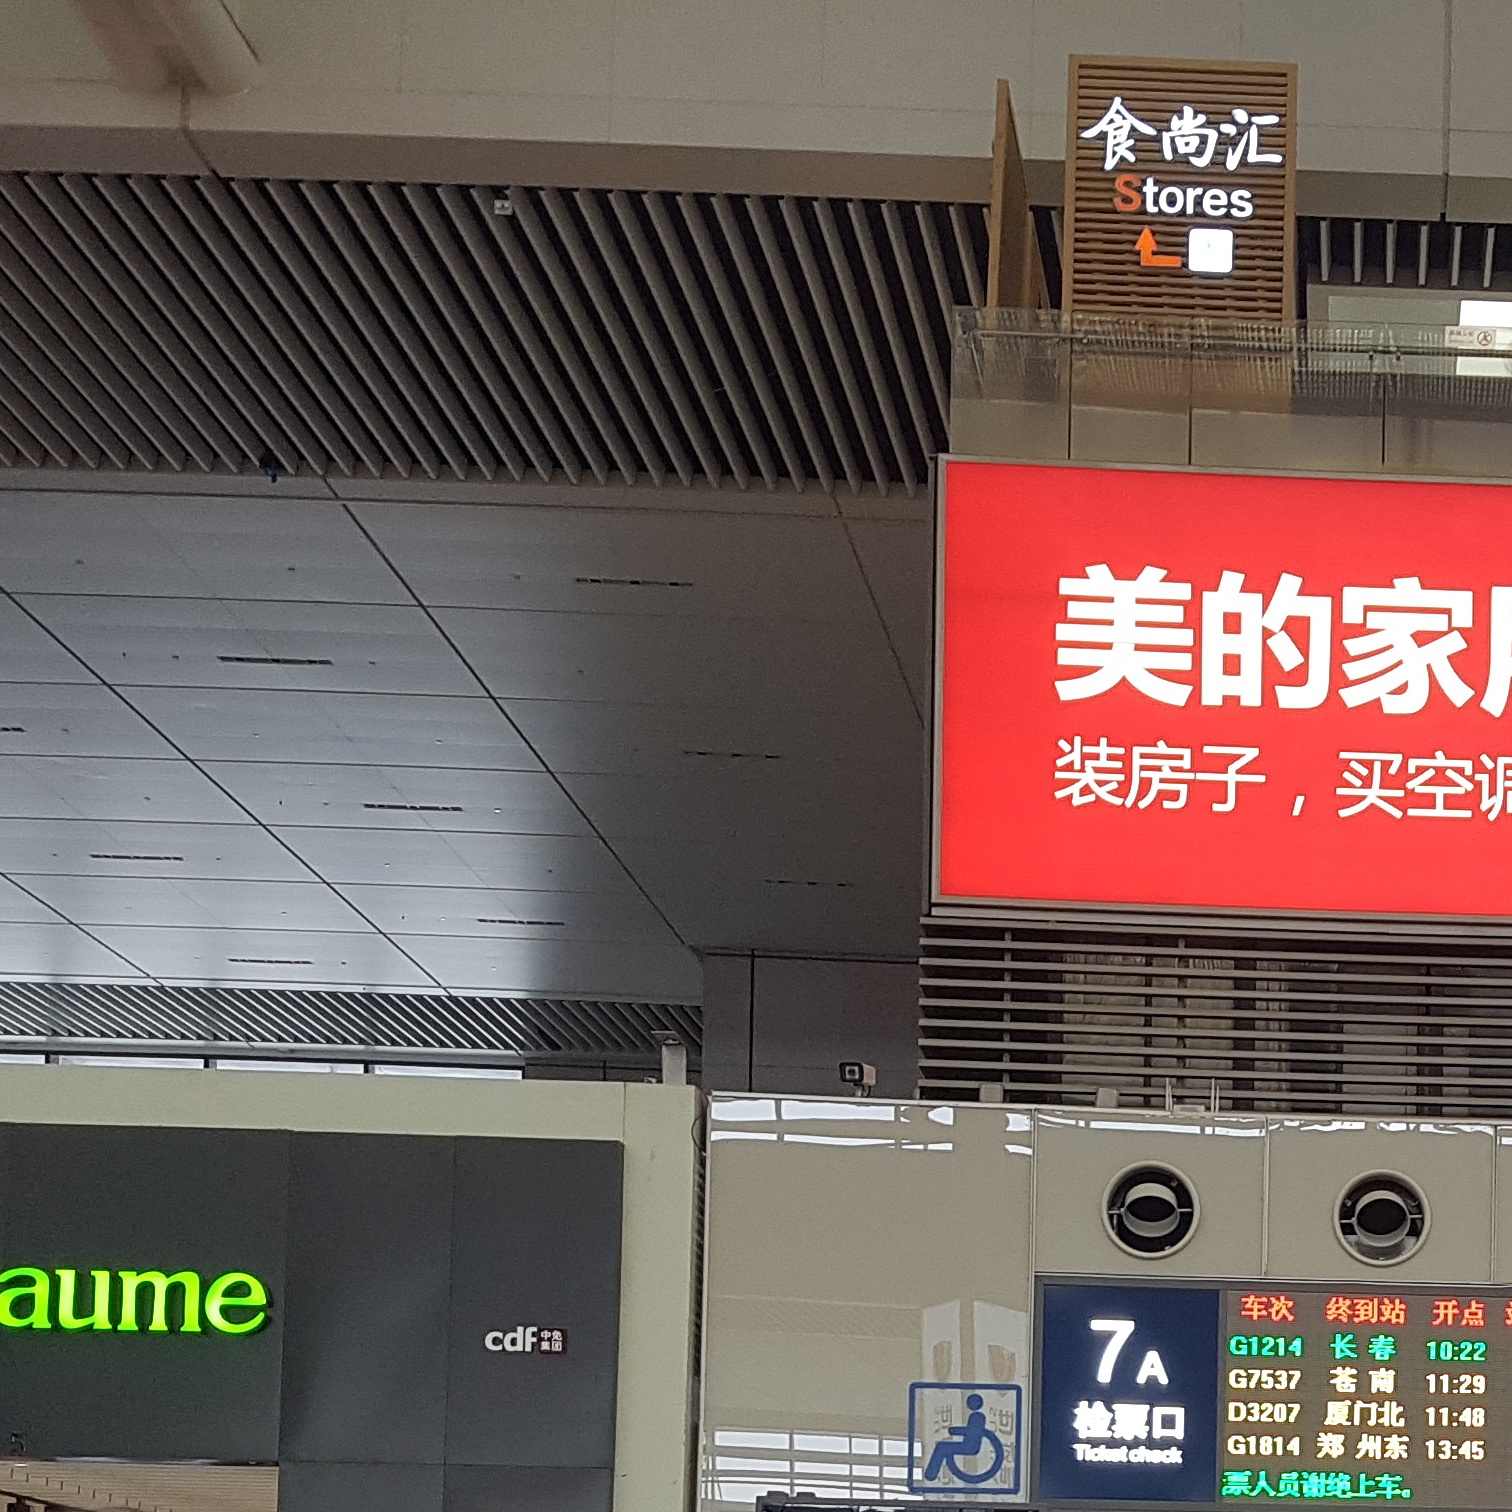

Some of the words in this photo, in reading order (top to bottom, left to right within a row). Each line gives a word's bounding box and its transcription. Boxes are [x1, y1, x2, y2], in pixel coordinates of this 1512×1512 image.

[1080, 96, 1283, 171] 食尚汇
[1113, 174, 1253, 218] Stores
[1241, 1295, 1295, 1322] 车次
[1325, 1297, 1406, 1324] 终到站
[1432, 1300, 1485, 1326] 开点
[484, 1326, 538, 1352] cdf
[1229, 1336, 1303, 1356] G1214
[1426, 1342, 1486, 1361] 10:22
[1229, 1369, 1301, 1389] G7537
[1426, 1374, 1486, 1394] 11:29
[1075, 1401, 1185, 1440] 检票口
[1228, 1402, 1300, 1422] D3207
[1324, 1400, 1405, 1426] 厦门北
[1425, 1407, 1485, 1427] 11:48
[1073, 1444, 1128, 1462] Ticket
[1129, 1445, 1182, 1463] check
[1227, 1435, 1300, 1455] G1814
[1425, 1440, 1485, 1460] 13:45
